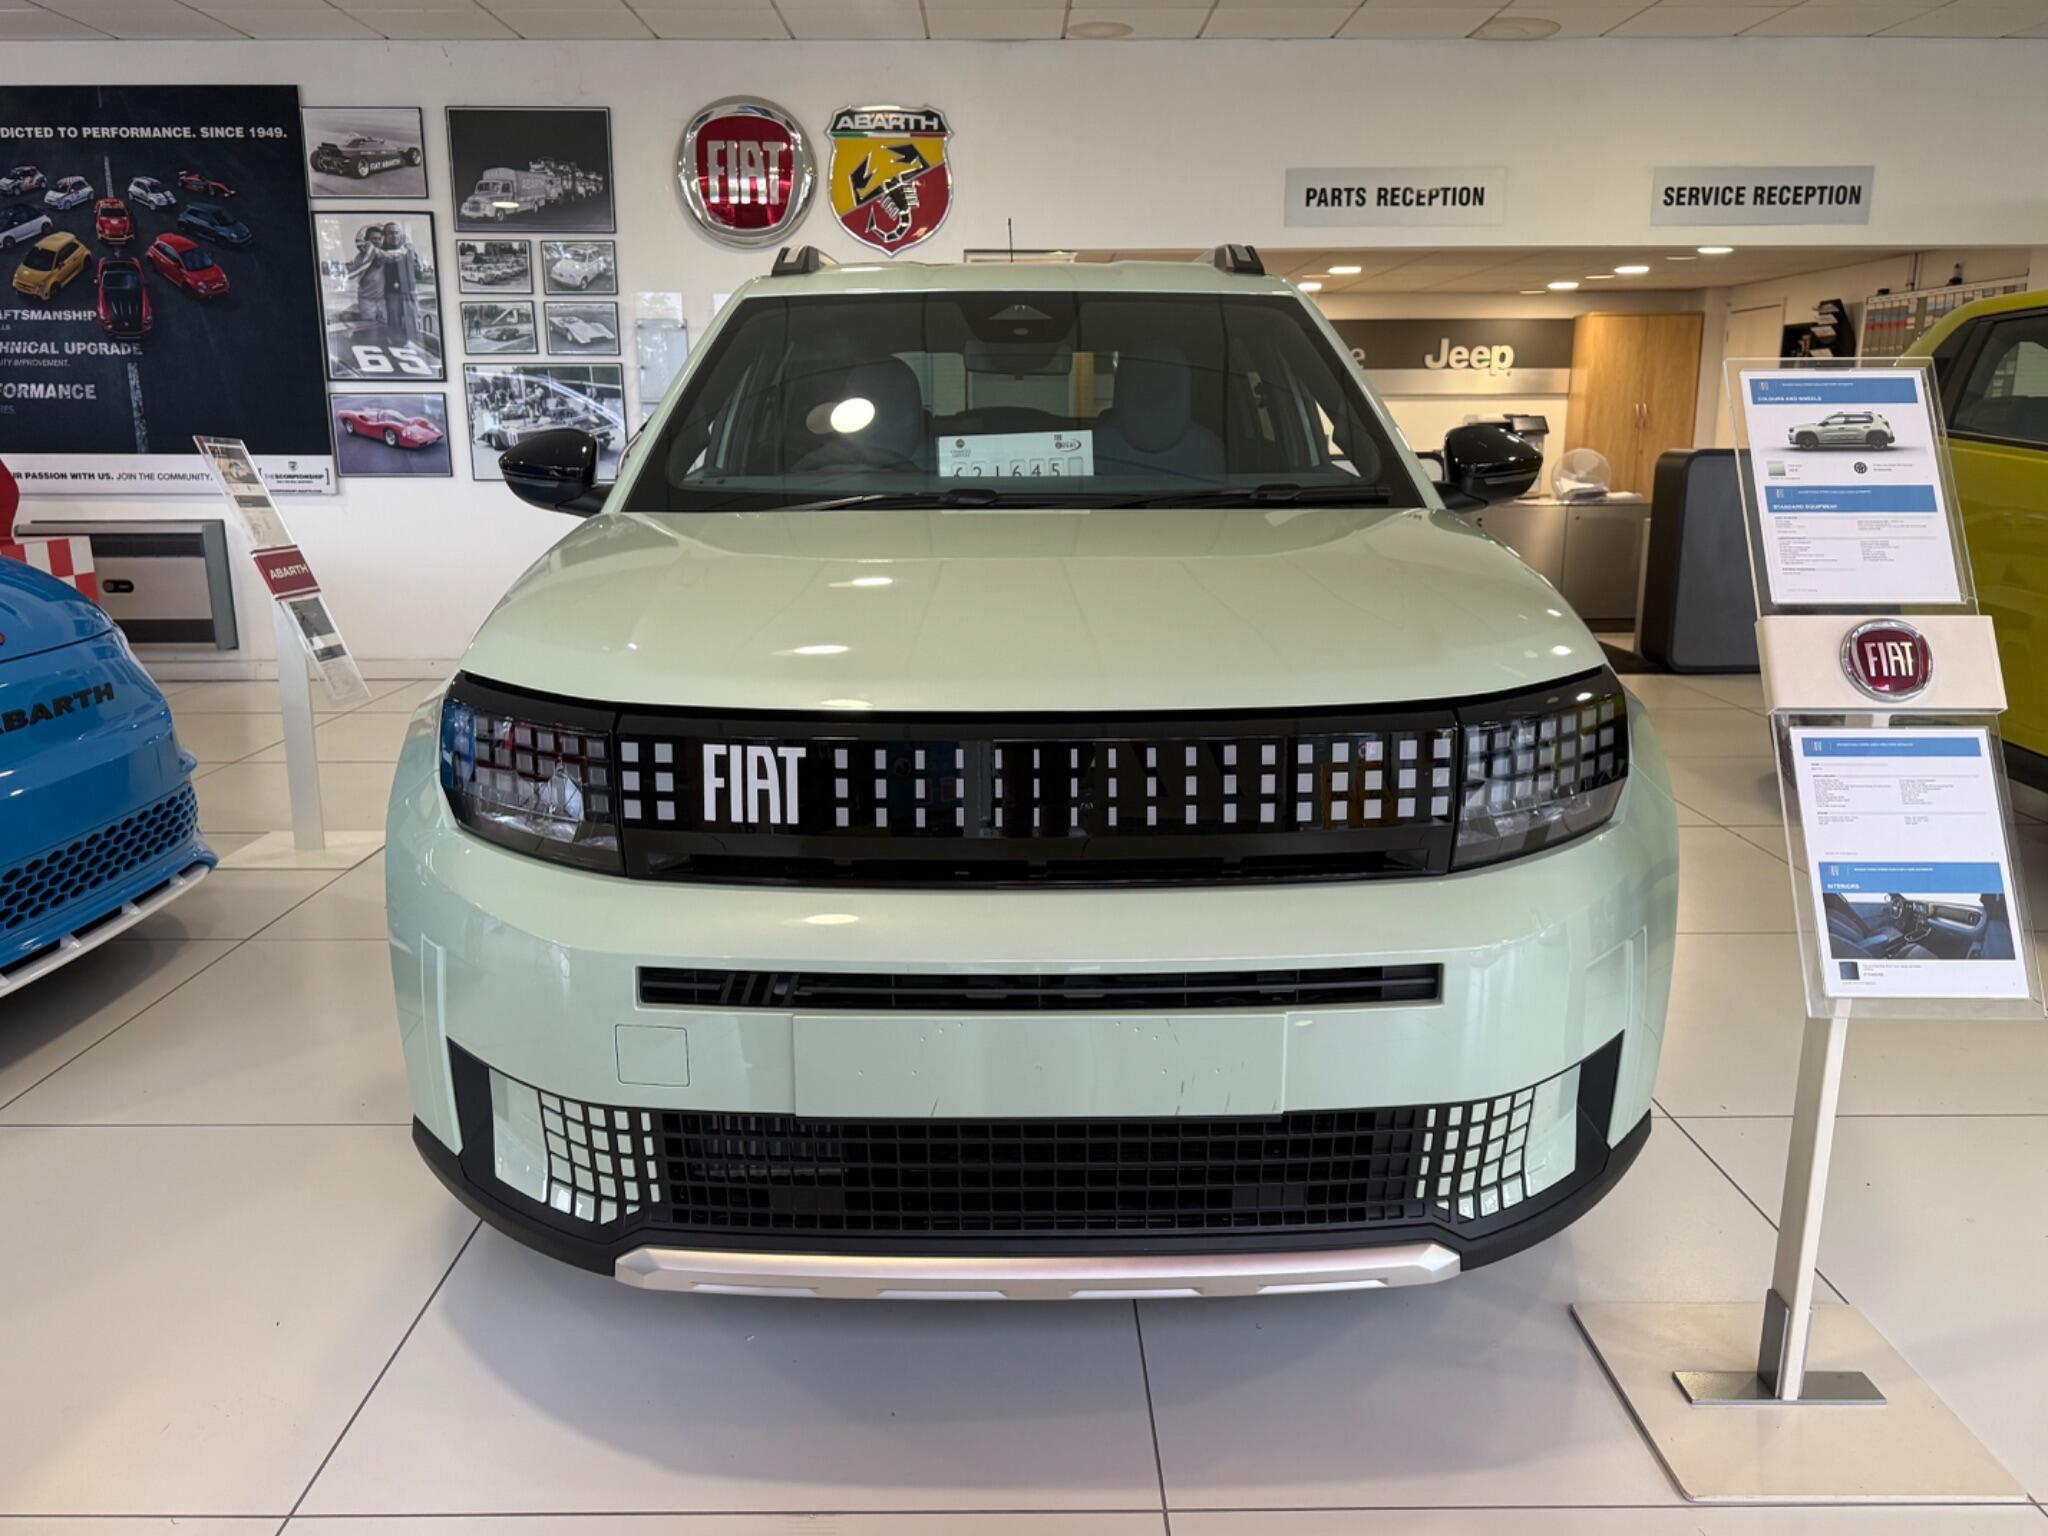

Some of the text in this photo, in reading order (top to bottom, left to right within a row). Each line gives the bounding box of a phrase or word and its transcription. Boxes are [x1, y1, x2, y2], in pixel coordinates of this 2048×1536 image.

[836, 113, 939, 130] ABARTH
[0, 127, 287, 139] DICTED TO PERFORMANCE. SINCE 1949.
[707, 139, 787, 204] FIAT
[1305, 186, 1485, 207] PARTS RECEPTION
[1662, 185, 1862, 206] SERVICE RECEPTION
[63, 342, 143, 355] UPGRADE
[1424, 337, 1515, 376] Jeep
[352, 345, 432, 375] 65
[25, 471, 67, 480] PASSION
[70, 471, 96, 480] WITH
[98, 471, 114, 480] US.
[116, 472, 137, 481] JOIN
[139, 472, 155, 481] THE
[157, 472, 213, 481] COMMUNITY.
[270, 562, 309, 579] ABARTH
[1863, 641, 1914, 677] FIAT
[0, 682, 114, 735] BARTH
[703, 743, 806, 824] FIAT
